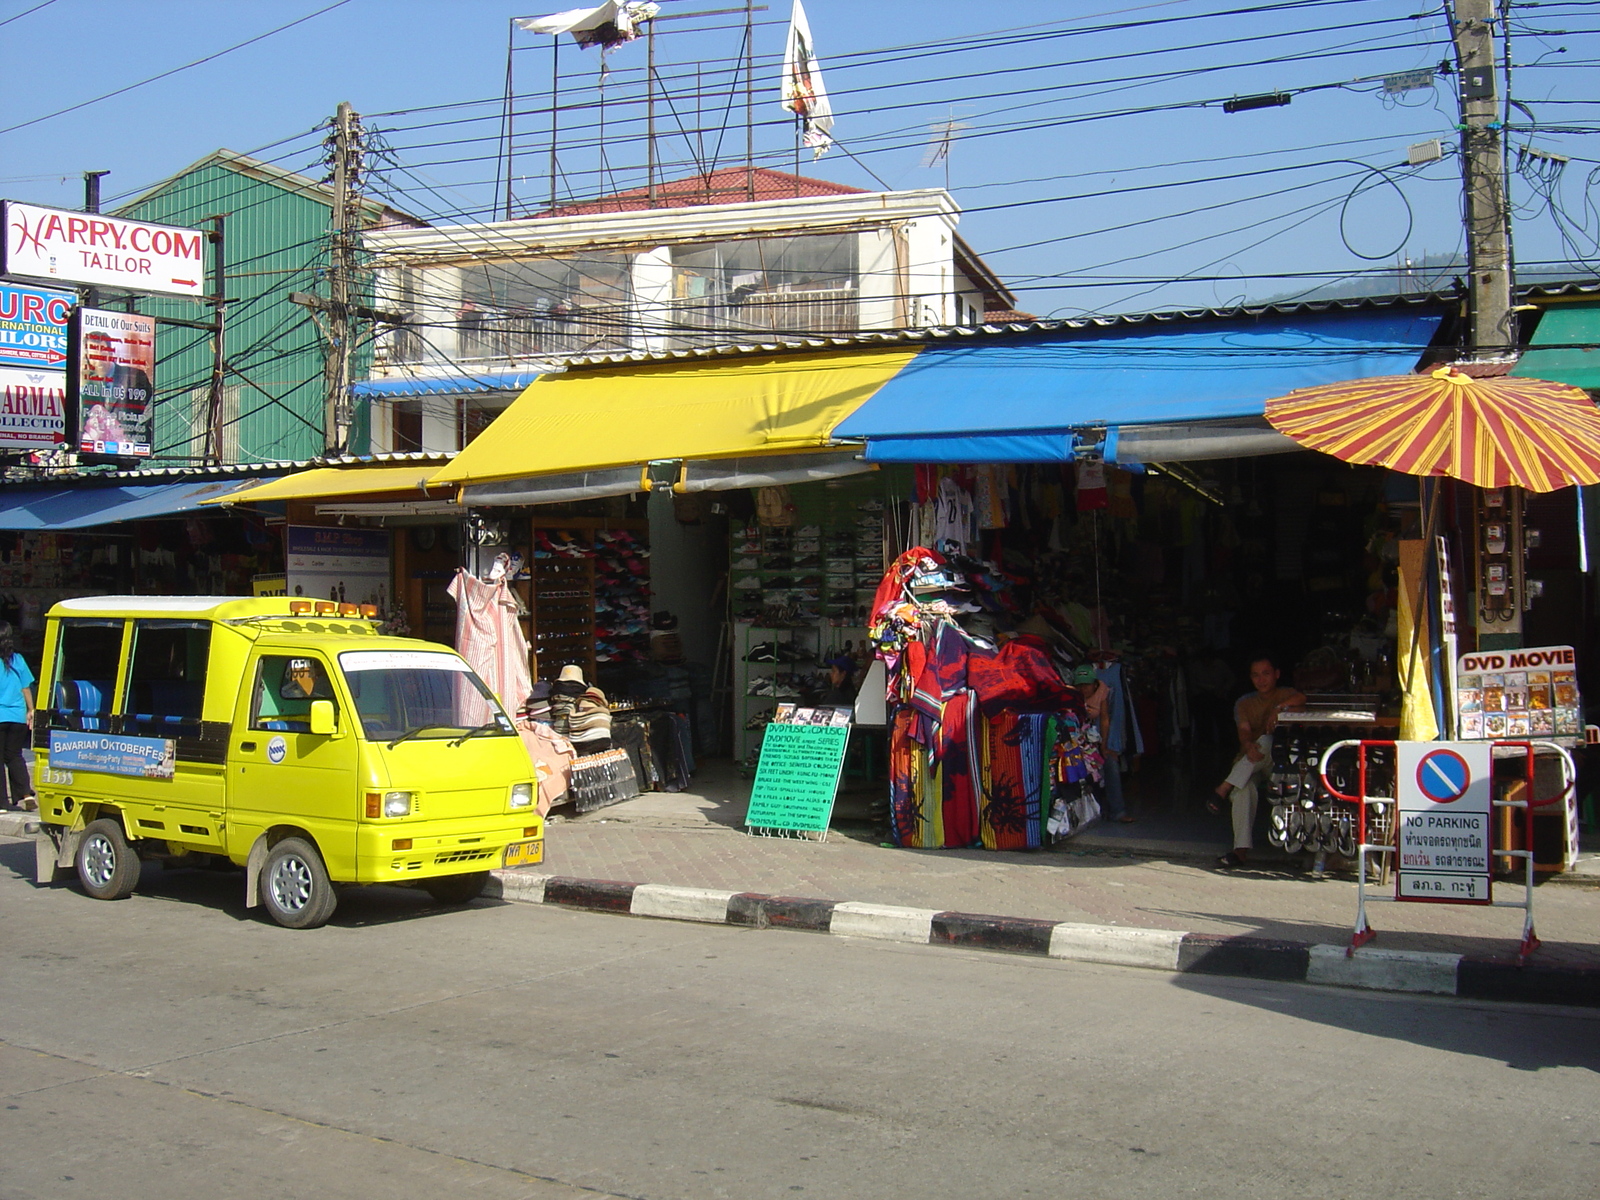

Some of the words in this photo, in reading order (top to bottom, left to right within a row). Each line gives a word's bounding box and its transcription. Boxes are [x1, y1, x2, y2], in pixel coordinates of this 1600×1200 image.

[79, 251, 152, 275] TAILOR
[0, 321, 64, 336] RNATIONAL
[84, 314, 110, 328] DETAIL
[111, 318, 120, 330] Of
[120, 320, 132, 330] Our
[134, 322, 151, 333] Suits
[82, 384, 100, 397] ALL
[128, 388, 147, 401] 199
[0, 416, 64, 429] LLECTIO
[1464, 656, 1504, 672] DVD
[1510, 650, 1574, 668] MOVIE
[54, 740, 98, 753] BAVARIAN
[1406, 816, 1422, 828] NO
[1428, 818, 1480, 829] PARKING
[526, 842, 540, 856] 126
[1403, 850, 1430, 866] ยกเว้น
